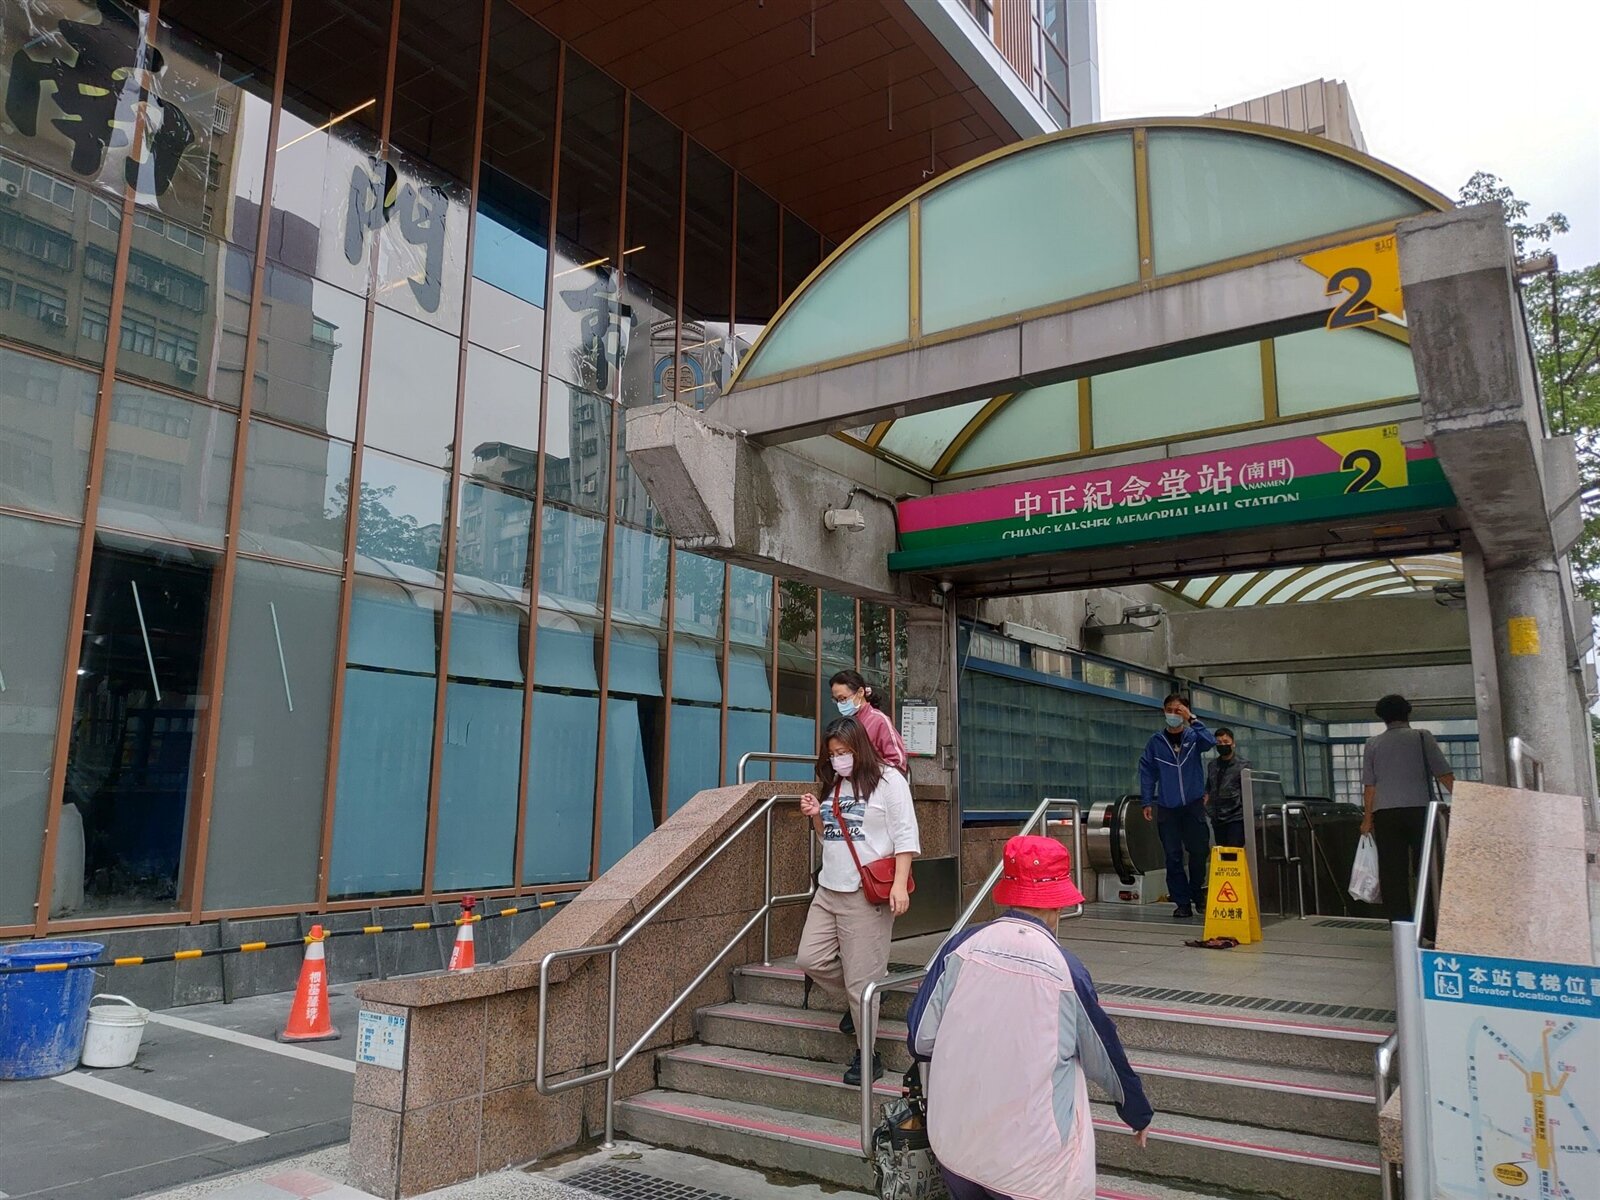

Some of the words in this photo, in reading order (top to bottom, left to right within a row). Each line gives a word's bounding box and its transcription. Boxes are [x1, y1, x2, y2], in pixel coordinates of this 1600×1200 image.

[1325, 267, 1378, 331] 2
[1248, 479, 1286, 491] NANMEN
[1341, 448, 1387, 494] 2
[1014, 461, 1233, 522] 中正紀念堂站
[1212, 906, 1244, 919] 小心地滑
[1469, 984, 1510, 997] Elevator
[1512, 989, 1558, 1002] Location
[1560, 994, 1592, 1006] Guide
